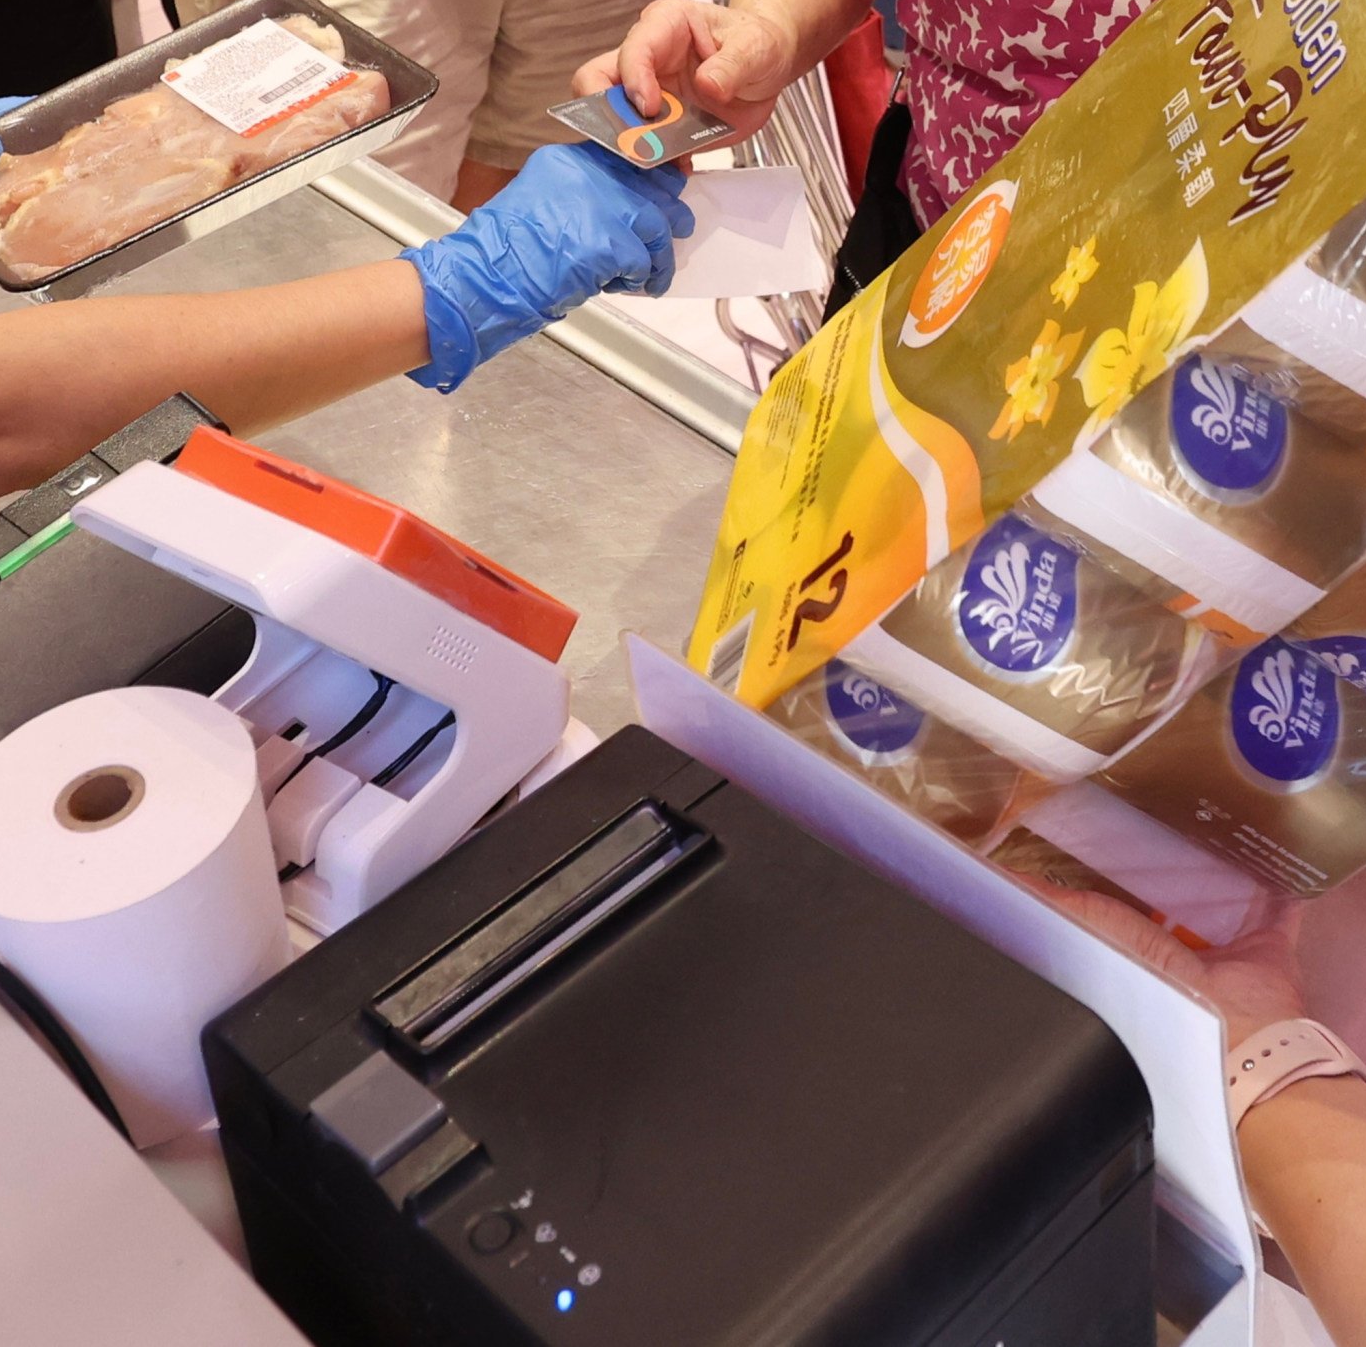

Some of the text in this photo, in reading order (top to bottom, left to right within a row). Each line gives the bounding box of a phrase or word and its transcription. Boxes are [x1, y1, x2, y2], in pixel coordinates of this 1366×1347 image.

[1230, 386, 1259, 451] Vin
[786, 529, 855, 653] 12
[1009, 549, 1057, 647] Vinda
[1284, 657, 1321, 750] Vinda
